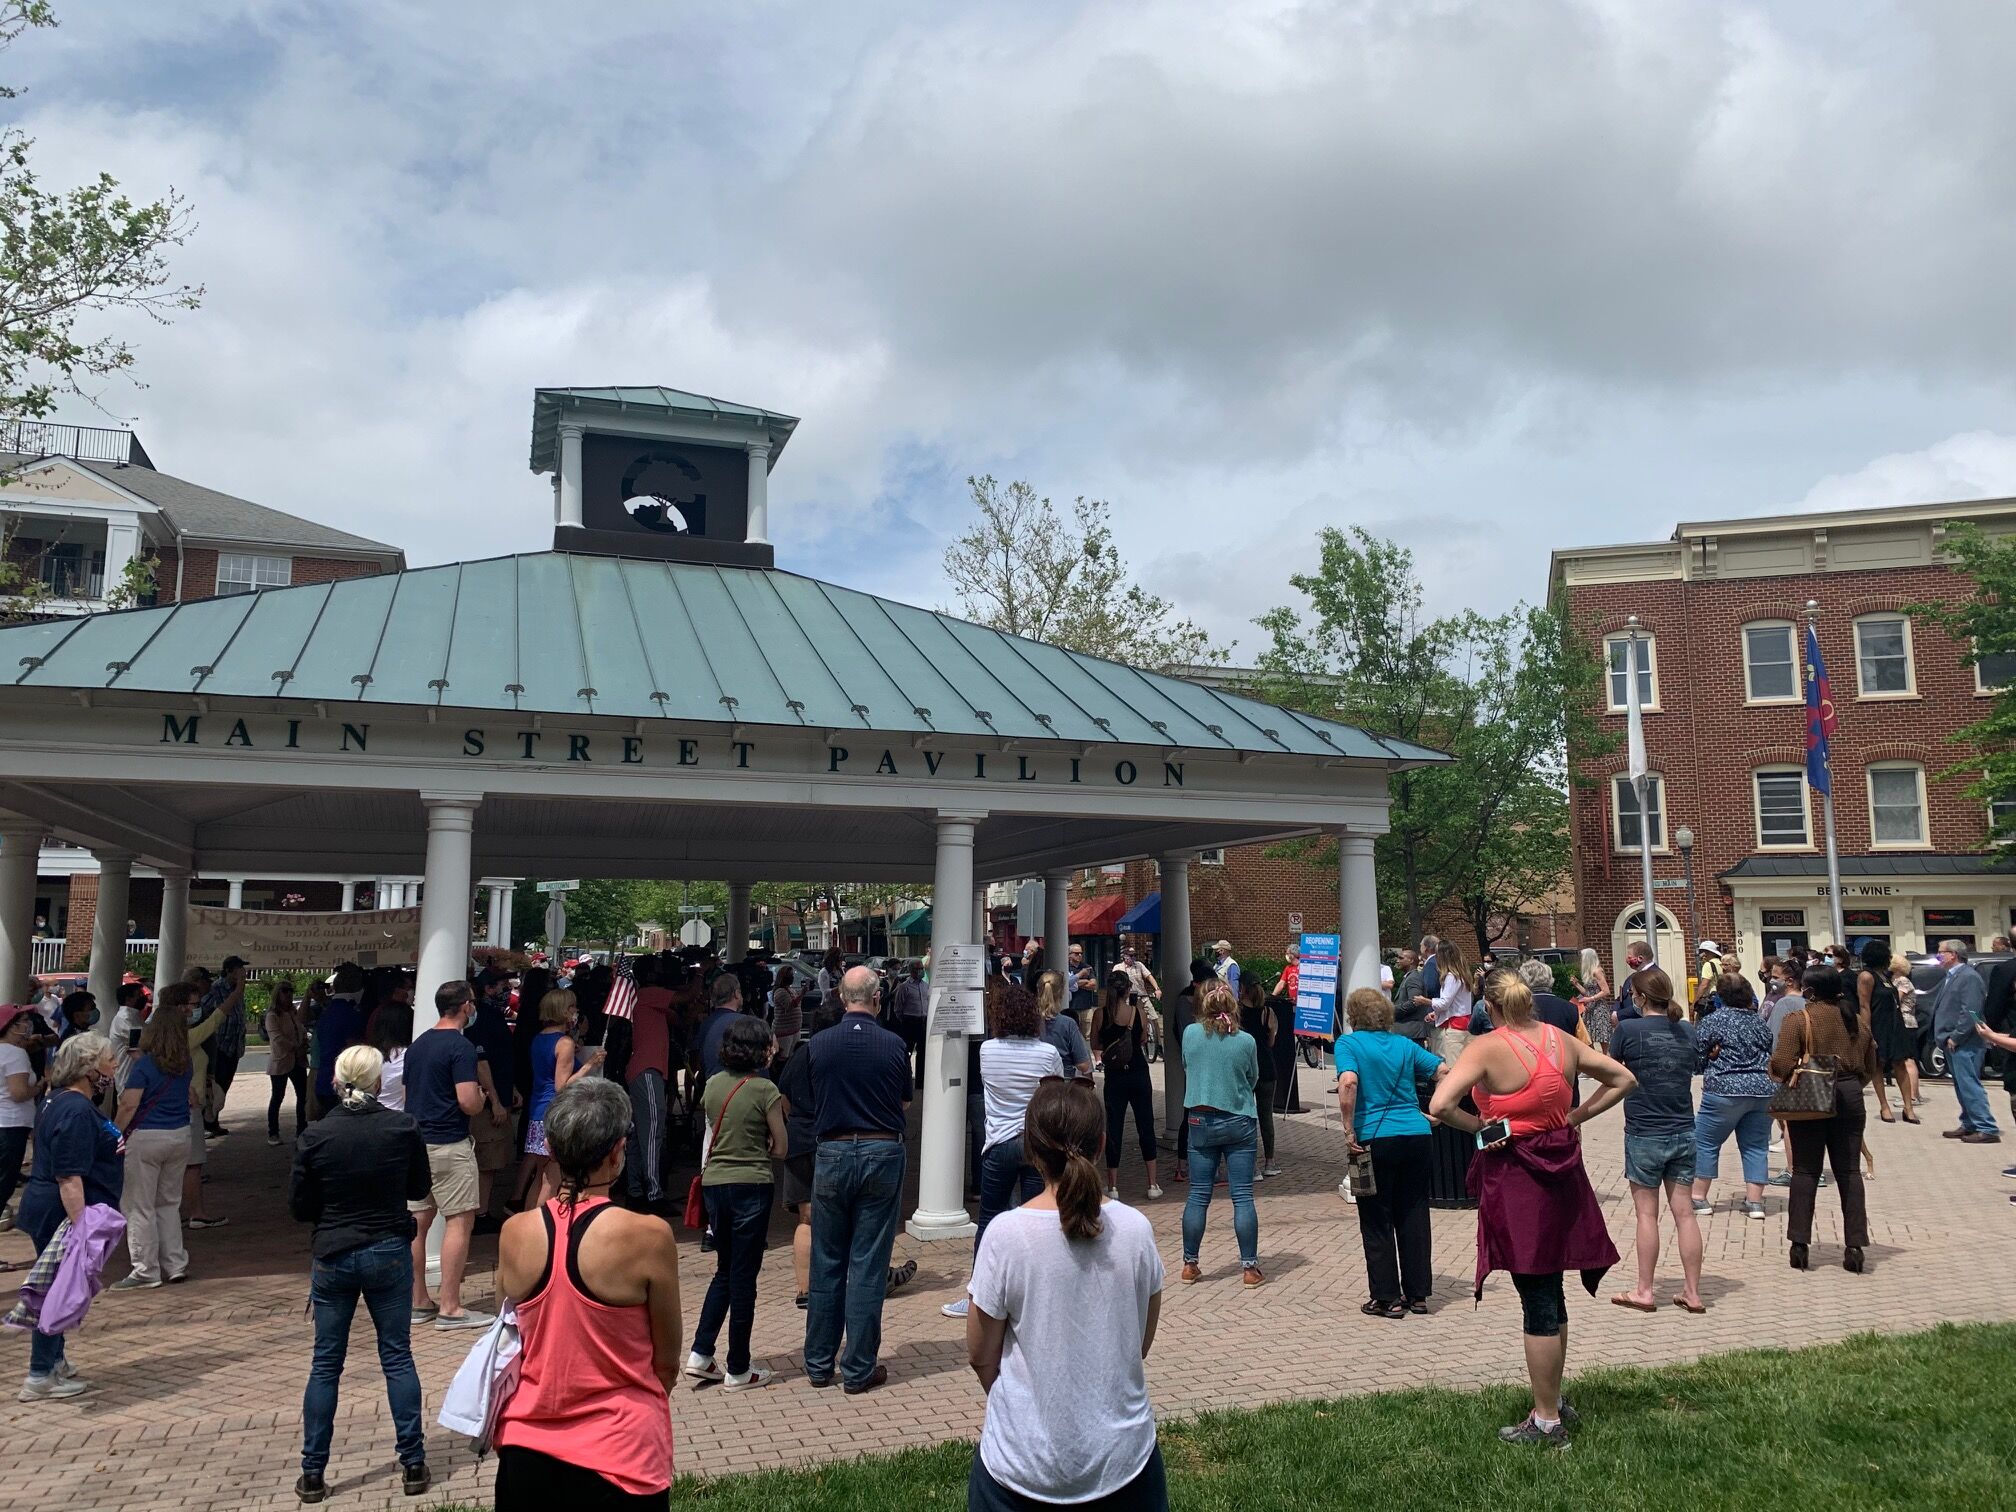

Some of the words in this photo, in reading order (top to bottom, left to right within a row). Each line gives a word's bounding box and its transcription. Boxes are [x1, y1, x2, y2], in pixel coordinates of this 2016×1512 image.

[160, 714, 371, 751] MAIN
[463, 729, 755, 768] STREET
[829, 746, 1187, 787] PAVILION
[1817, 886, 1849, 896] BER
[1859, 886, 1892, 896] WINE
[1768, 912, 1800, 925] OPEN
[1305, 936, 1334, 945] REOPENING
